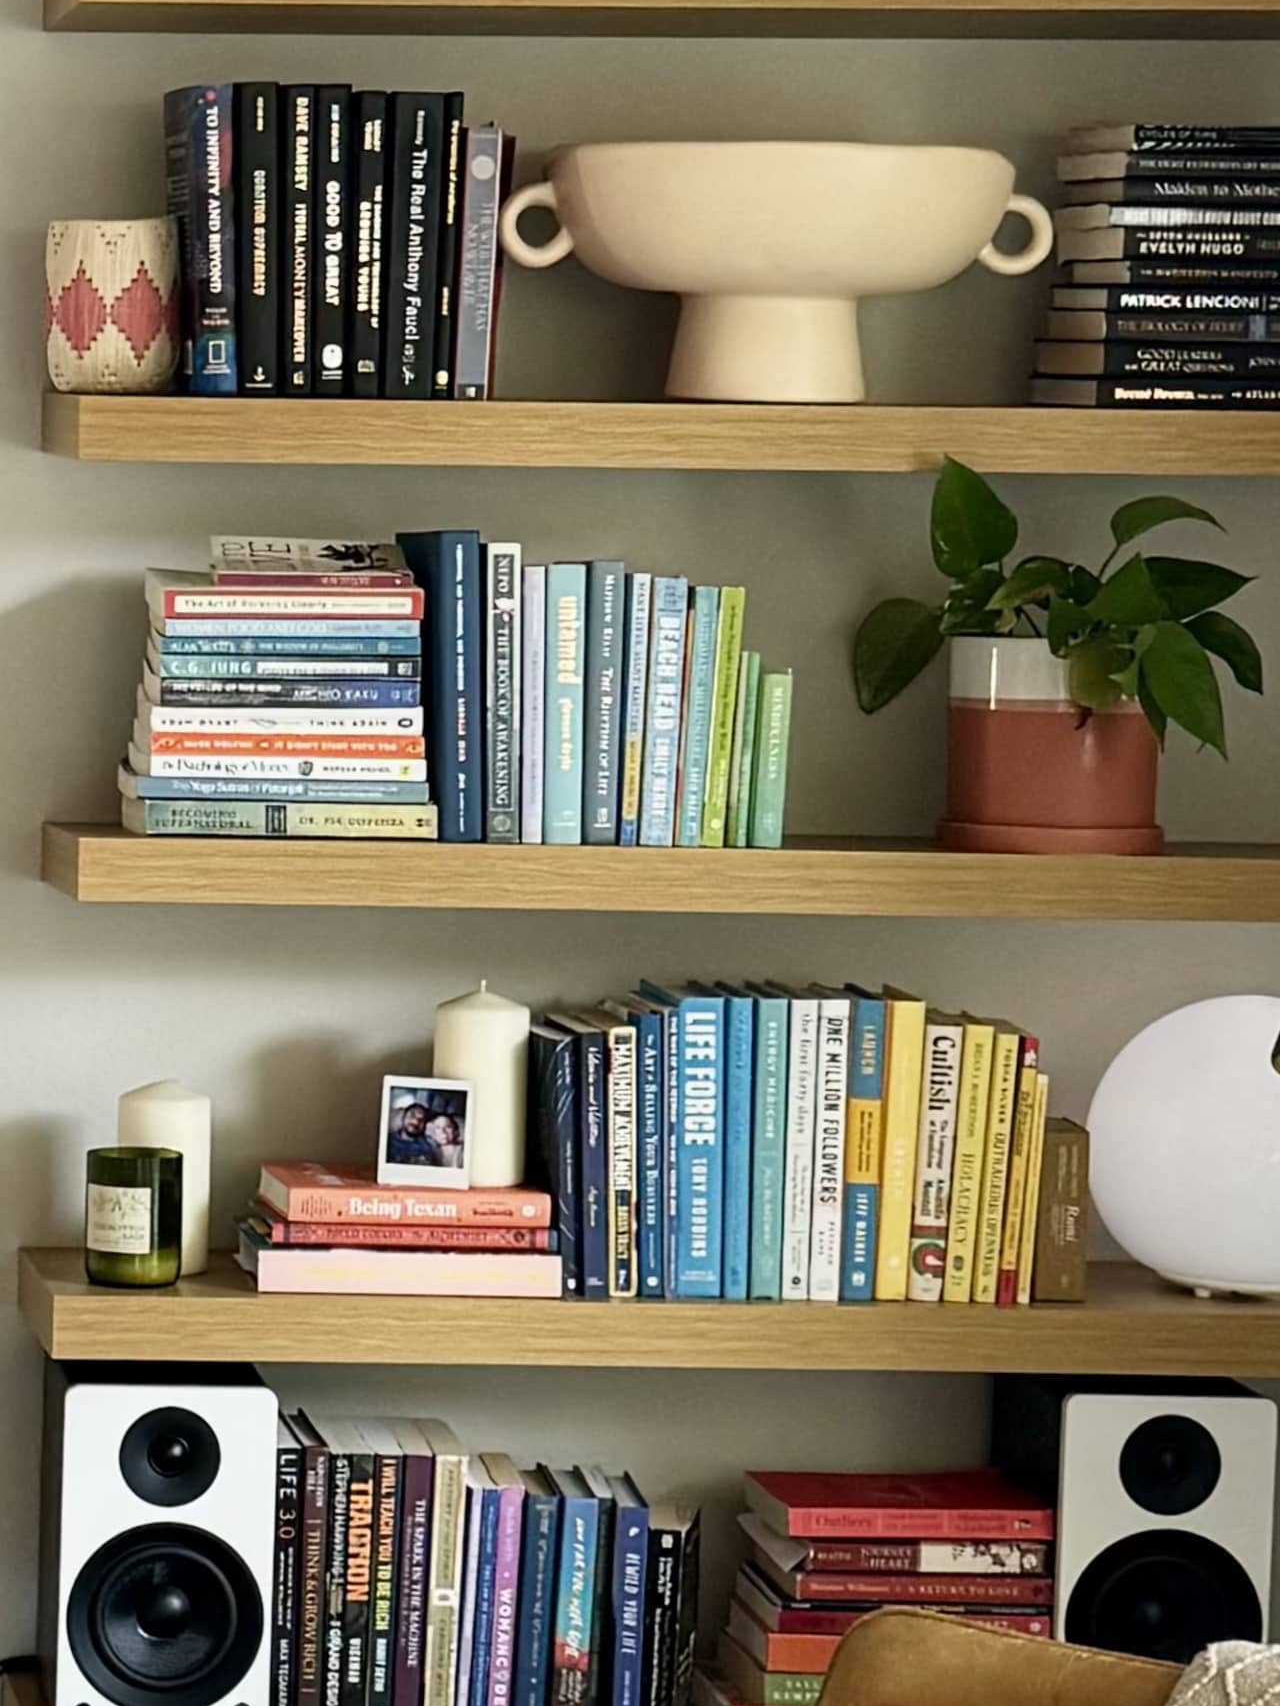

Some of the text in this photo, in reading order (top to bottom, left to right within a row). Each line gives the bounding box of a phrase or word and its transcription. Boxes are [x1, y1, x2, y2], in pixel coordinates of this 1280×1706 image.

[295, 96, 309, 191] DAVE RAMSEY
[412, 149, 428, 180] The
[206, 105, 223, 292] TO INFINITY AND BEYOND
[410, 183, 427, 221] Real
[1213, 184, 1229, 196] to
[325, 180, 342, 306] GOOD TO GREAT
[402, 224, 424, 292] Anthony
[1139, 242, 1245, 255] EVELYN HUGO
[404, 296, 421, 340] Fauci
[1120, 294, 1260, 309] PATRICK LENCIONI
[209, 660, 252, 674] JUNG
[495, 557, 510, 806] NEPO THE BOOK OF AWAKENING
[652, 616, 680, 731] BEACH READ
[599, 696, 613, 750] RHYTHM
[768, 686, 784, 780] MINDFULNESS
[597, 770, 610, 795] LIFE
[599, 753, 612, 769] OF
[649, 737, 671, 816] EMILY HENRY
[645, 1047, 658, 1074] ART
[796, 1013, 813, 1134] the first forty days
[861, 1024, 876, 1074] LAUNCH
[927, 1035, 956, 1112] Cultish
[684, 1011, 716, 1146] LIFE FORCE
[764, 1021, 778, 1138] ENERGY MEDICINE
[612, 1043, 632, 1191] MAXIMUM ACHIEVEMENT
[646, 1083, 659, 1134] SELLING
[819, 1016, 845, 1204] ONE MILLION FOLLOWERS
[645, 1134, 660, 1166] YOUR
[349, 1197, 457, 1220] Being Texan
[690, 1157, 708, 1258] TONY ROBBINS
[952, 1152, 976, 1246] HOLACRACY
[982, 1132, 1007, 1276] OUTRAGEOUS OPENNESS
[1065, 1205, 1081, 1242] Rumi
[854, 1192, 869, 1262] JEFF WALKER
[279, 1453, 297, 1540] LIFE 3.0
[381, 1463, 394, 1493] WILL
[332, 1458, 348, 1578] STEPHEN HAWKING
[346, 1479, 373, 1603] TRACTION
[379, 1496, 393, 1536] TEACH
[815, 1514, 873, 1530] Outliers
[378, 1563, 391, 1581] TO
[379, 1537, 392, 1561] YOU
[869, 1557, 912, 1569] HEART
[303, 1529, 321, 1679] THINK & GROW RICH
[377, 1582, 390, 1598] BE
[407, 1499, 426, 1667] THE SPARK IN THE MACHINE
[621, 1552, 641, 1655] REWILD YOUR LIFE
[375, 1599, 391, 1631] RICH
[277, 1638, 289, 1660] MAX
[328, 1627, 341, 1670] GRAND
[347, 1637, 361, 1683] WICKMAN
[373, 1666, 386, 1692] SETHI
